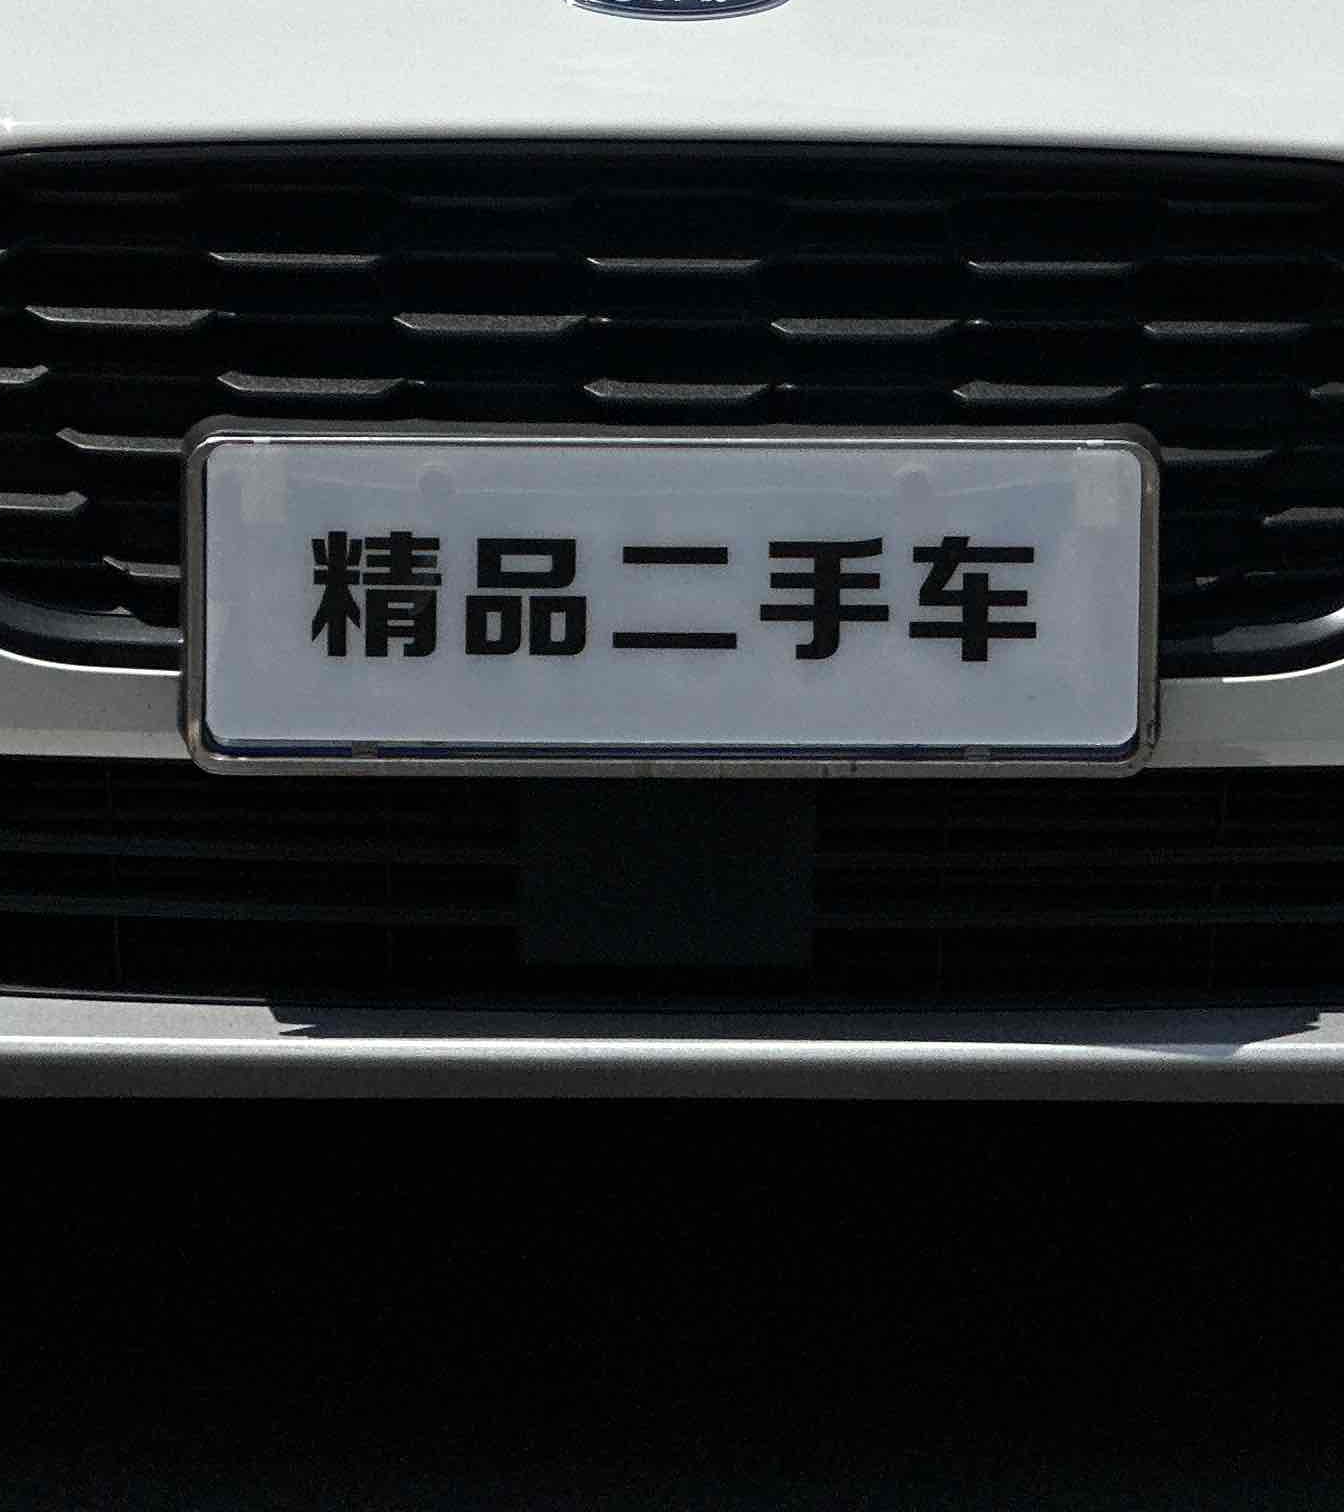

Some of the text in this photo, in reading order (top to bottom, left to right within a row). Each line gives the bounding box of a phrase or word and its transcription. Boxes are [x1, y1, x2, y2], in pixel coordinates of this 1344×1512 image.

[310, 531, 1037, 662] 精品二手车
